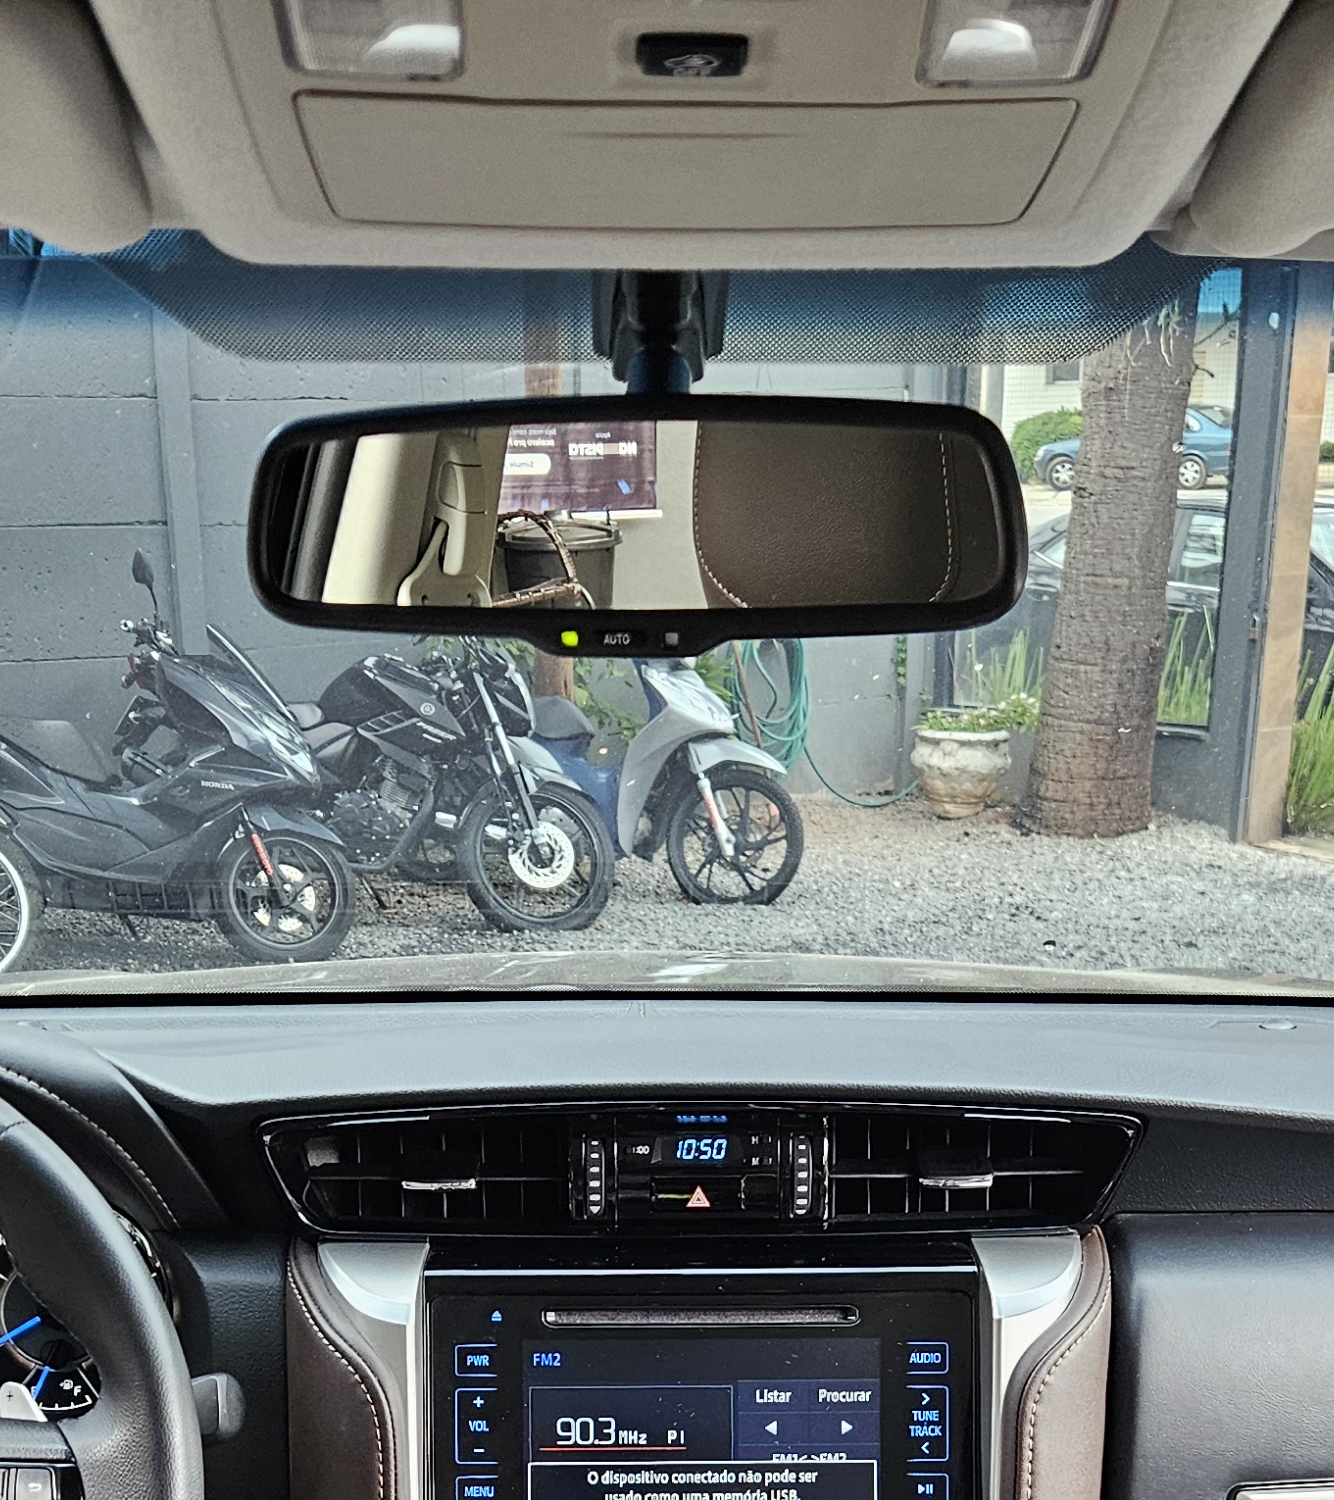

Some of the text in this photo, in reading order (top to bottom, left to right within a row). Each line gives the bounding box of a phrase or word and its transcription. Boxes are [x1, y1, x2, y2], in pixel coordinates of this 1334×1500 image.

[603, 632, 631, 645] AUTO
[200, 780, 235, 791] HONDA
[676, 1138, 728, 1160] 10:50
[466, 1355, 490, 1367] PWR
[533, 1353, 562, 1367] FM2
[73, 1386, 82, 1397] F
[755, 1389, 792, 1403] Listar
[818, 1389, 872, 1403] Procurar
[911, 1410, 940, 1421] TUNE
[468, 1420, 490, 1432] VOL
[556, 1417, 616, 1445] 90.3
[618, 1430, 648, 1445] MHz
[909, 1425, 942, 1437] TRACK
[587, 1469, 818, 1488] O dispositivo conectado não pode ser
[464, 1486, 495, 1498] MENU
